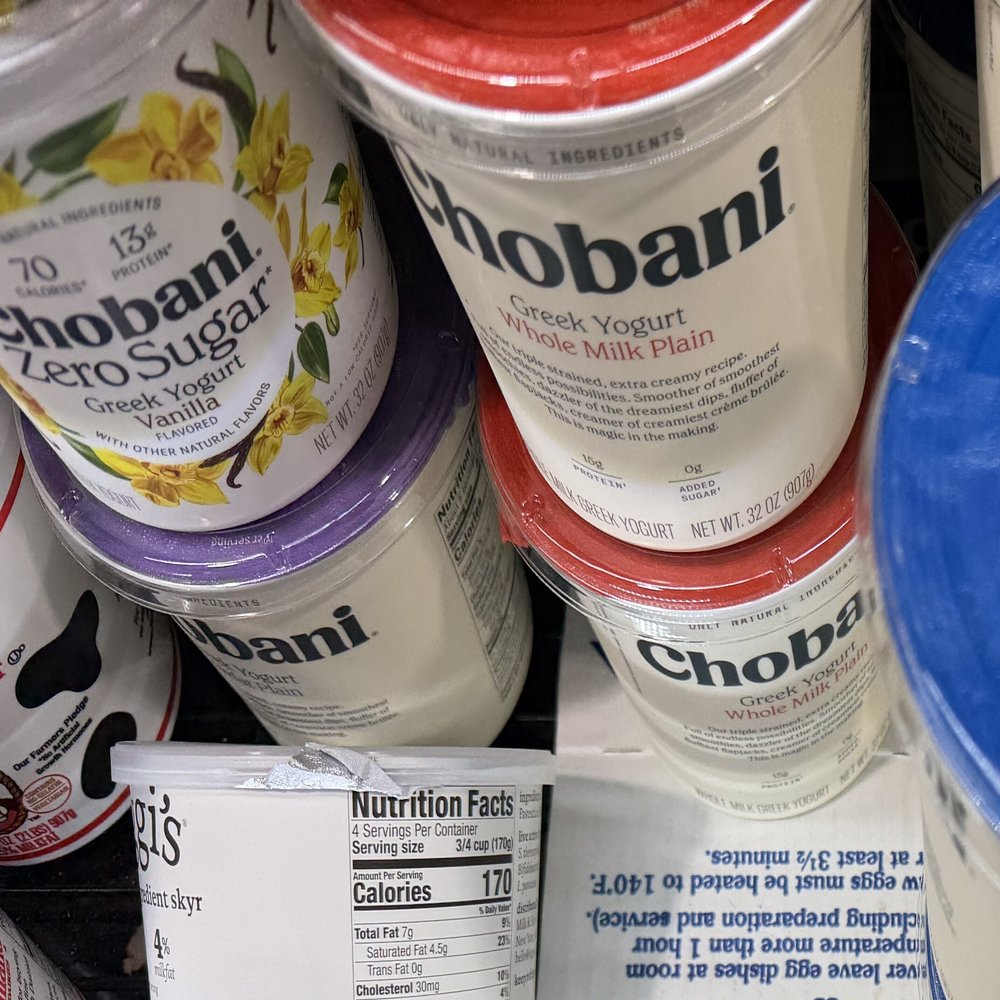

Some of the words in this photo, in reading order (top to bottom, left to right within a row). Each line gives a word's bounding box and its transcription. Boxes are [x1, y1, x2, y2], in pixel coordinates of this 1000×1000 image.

[451, 135, 534, 165] NATURAL
[548, 127, 686, 165] INGREDIENTS
[109, 222, 157, 260] 13g
[8, 256, 58, 282] 70
[509, 295, 587, 334] Greek
[592, 307, 687, 338] Yogurt
[498, 306, 578, 355] Whole
[581, 337, 645, 361] Milk
[649, 328, 714, 358] Plain
[3, 344, 130, 388] Zero
[84, 391, 163, 416] Greek
[162, 355, 246, 400] Yogurt
[95, 430, 129, 449] WITH
[133, 443, 177, 457] OTHER
[180, 428, 235, 456] NATURAL
[233, 382, 271, 428] FLAVORS
[134, 394, 222, 430] Vanilla
[156, 415, 218, 442] FLAVORED
[684, 463, 703, 476] 0g
[690, 519, 717, 539] NET
[719, 512, 744, 533] WT.
[746, 501, 763, 525] 32
[765, 490, 781, 514] OZ
[782, 464, 815, 504] (907g)
[724, 704, 787, 720] Whole
[791, 681, 832, 707] Milk
[834, 642, 869, 684] Plain
[739, 684, 798, 708] Greek
[801, 640, 857, 689] Yogurt
[352, 790, 462, 818] Nutrition
[468, 790, 513, 817] Facts
[352, 824, 358, 837] 4
[363, 823, 411, 840] Servings
[415, 825, 431, 836] Per
[435, 823, 478, 836] Container
[352, 841, 398, 856] Serving
[401, 842, 424, 853] size
[456, 839, 471, 851] 3/4
[474, 840, 489, 853] cup
[492, 837, 513, 852] (170g)
[706, 851, 790, 865] minutes.
[838, 851, 884, 866] least
[891, 851, 911, 865] at
[483, 868, 512, 896] 170
[663, 875, 683, 890] to
[690, 874, 758, 890] heated
[766, 875, 787, 890] be
[796, 876, 844, 890] must
[852, 872, 896, 892] eggs
[170, 888, 203, 915] skyr
[354, 882, 431, 903] Calories
[587, 909, 671, 926] service).
[678, 911, 713, 925] and
[722, 909, 840, 928] preparation
[355, 928, 379, 939] Total
[383, 927, 399, 938] Fat
[402, 927, 413, 939] 7g
[356, 983, 413, 996] Cholesterol
[415, 981, 440, 994] 30mg
